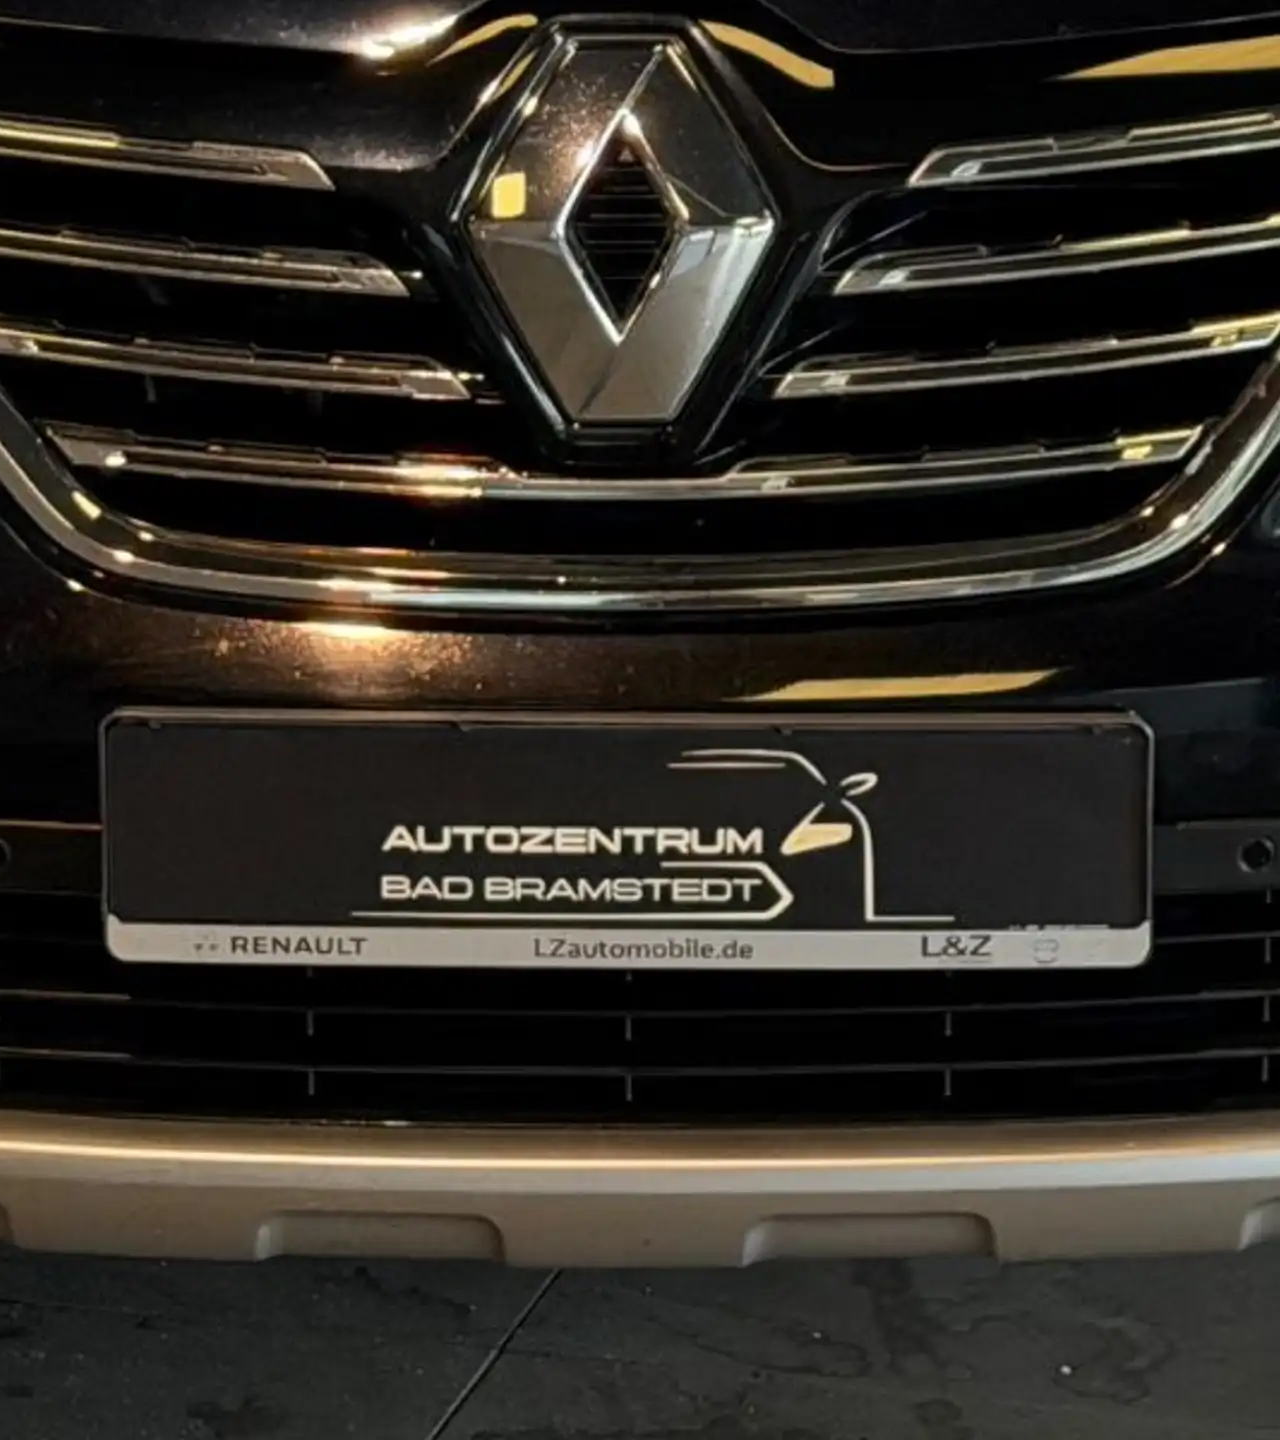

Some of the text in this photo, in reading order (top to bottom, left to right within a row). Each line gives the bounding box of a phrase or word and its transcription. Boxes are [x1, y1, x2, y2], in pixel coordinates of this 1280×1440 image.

[381, 825, 763, 854] AUTOZENTRUM
[380, 875, 762, 902] BAD BRAMSTEDT
[231, 935, 368, 955] RENAULT
[533, 936, 754, 960] LZautomobile.de
[921, 934, 992, 957] L&Z
